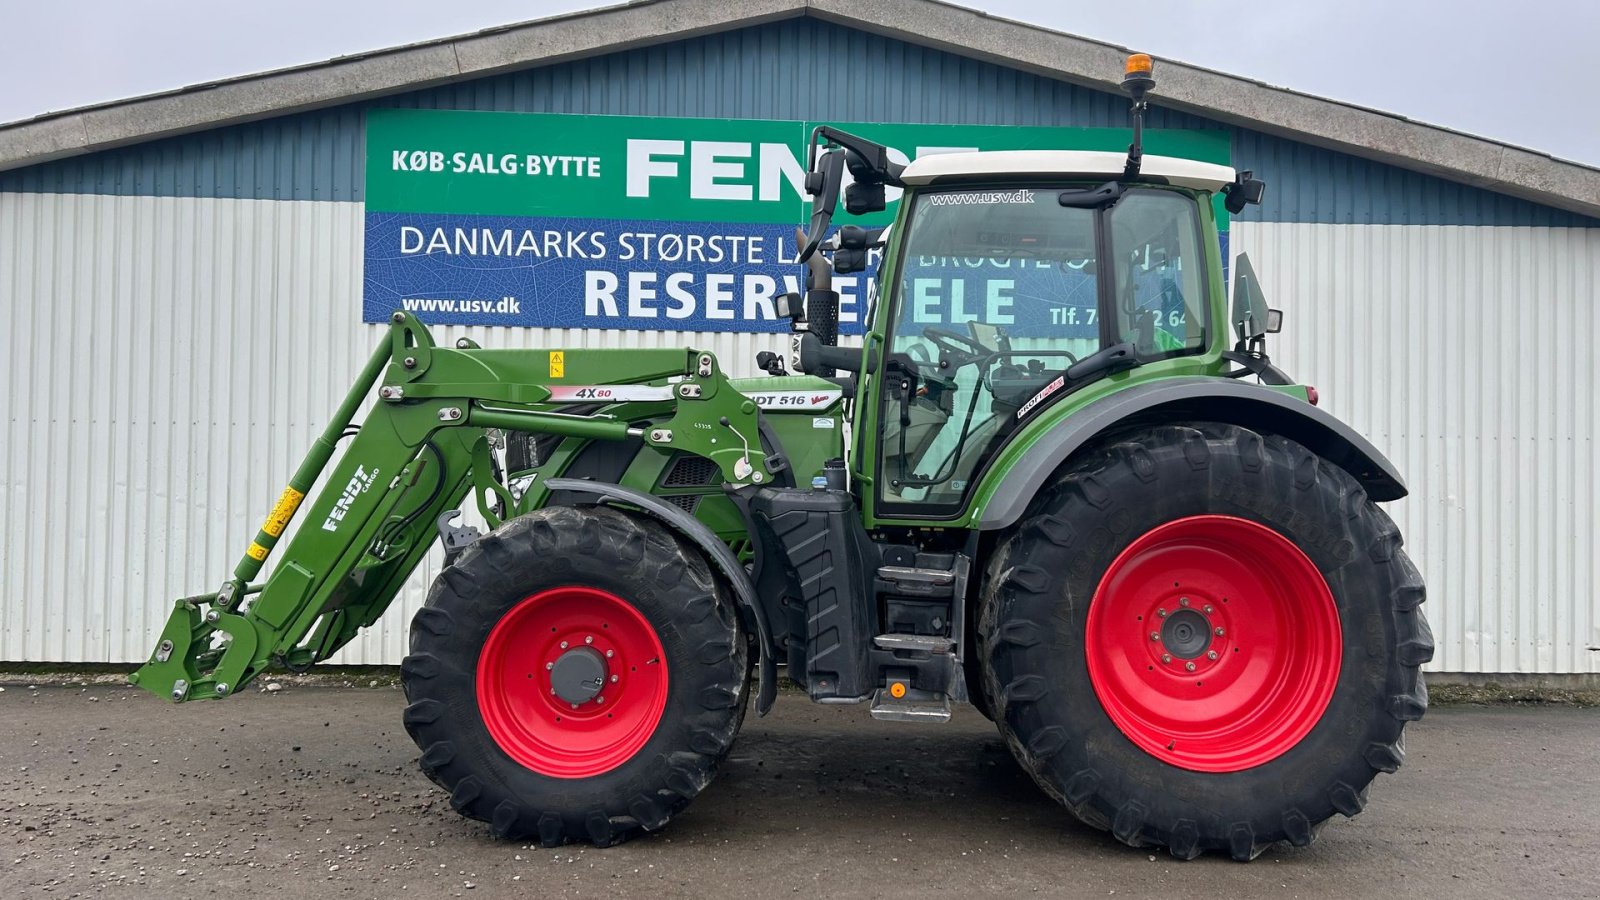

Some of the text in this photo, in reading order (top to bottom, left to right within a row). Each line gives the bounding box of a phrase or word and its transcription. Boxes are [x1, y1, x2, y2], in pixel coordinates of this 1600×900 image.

[930, 189, 1035, 206] www.usv.dk
[400, 226, 606, 259] DANMARKS
[618, 232, 764, 264] STØRSTE
[402, 297, 520, 314] www.usv.dk
[1050, 307, 1080, 325] Tlf.
[779, 396, 805, 405] 516
[361, 467, 380, 494] CARGO
[322, 464, 369, 532] FENDT
